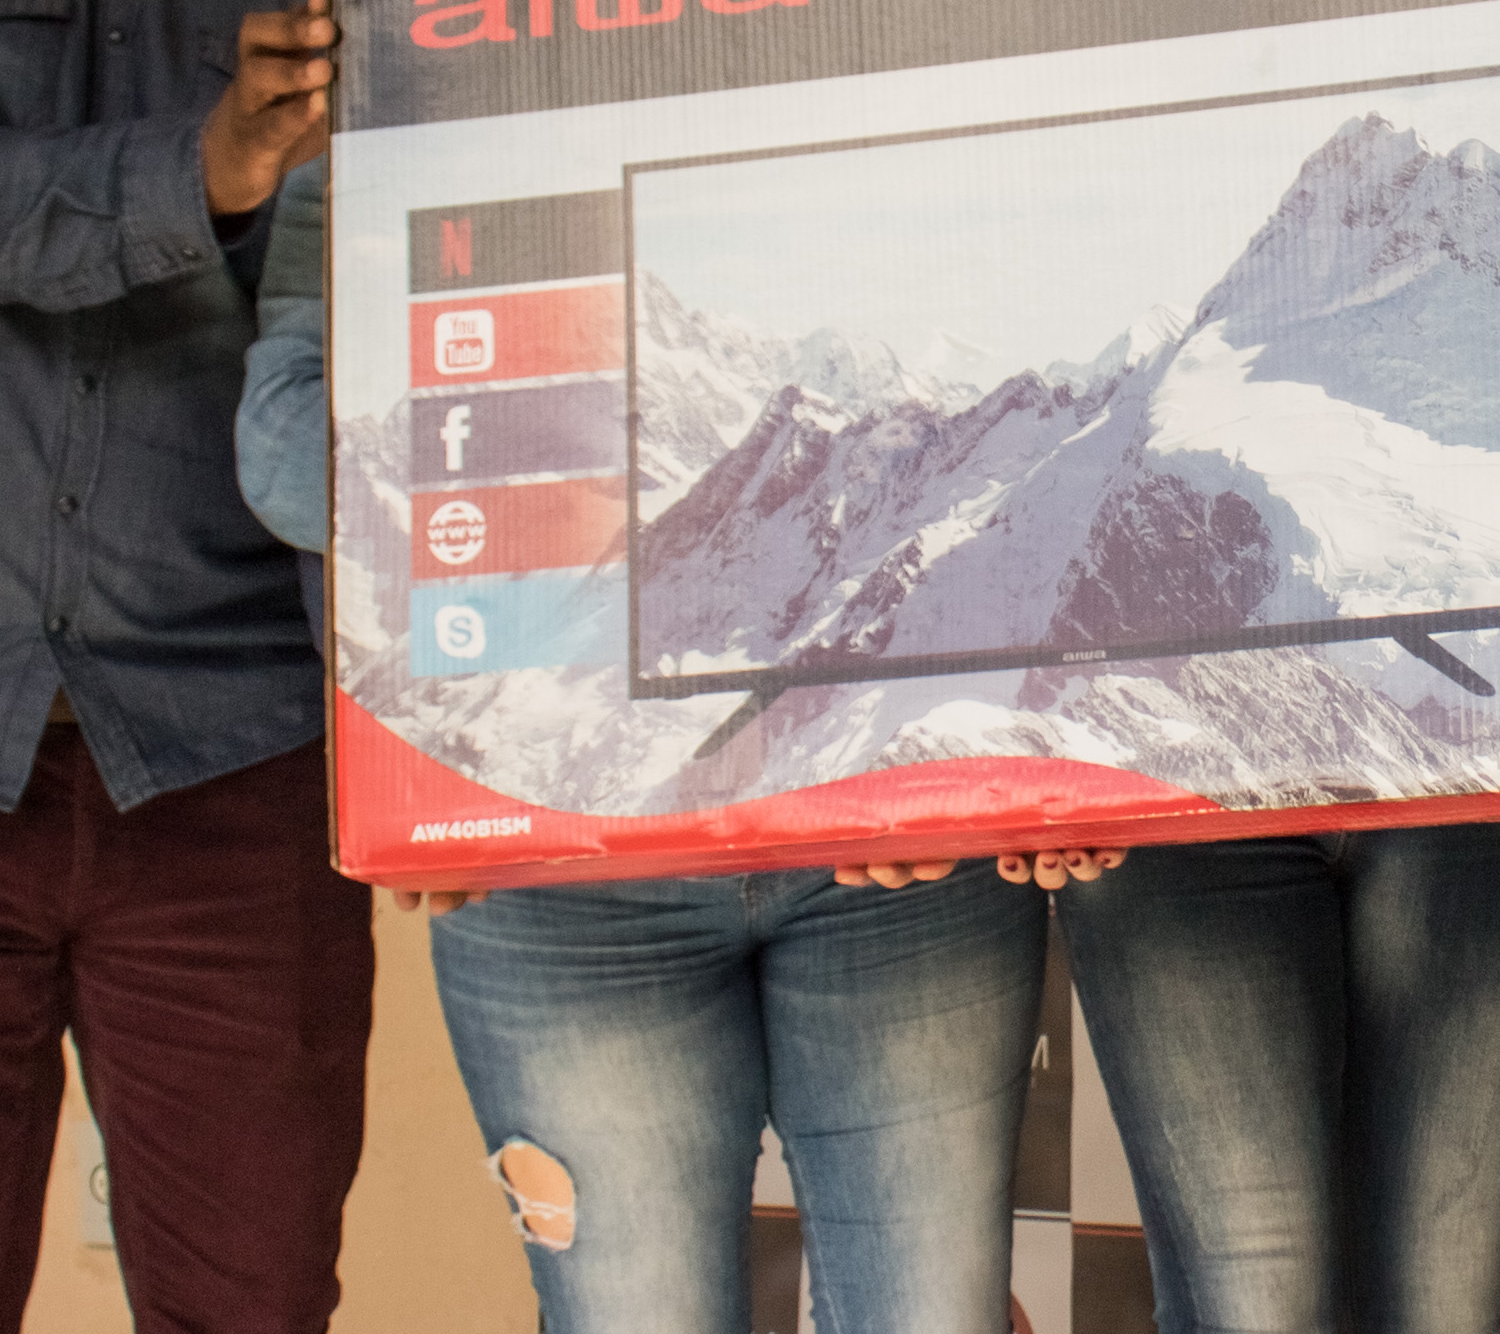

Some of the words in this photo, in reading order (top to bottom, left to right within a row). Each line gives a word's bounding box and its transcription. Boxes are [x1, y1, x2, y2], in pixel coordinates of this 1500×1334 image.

[449, 315, 478, 337] You
[446, 341, 484, 366] Tube
[410, 814, 532, 844] AW40B1SM
